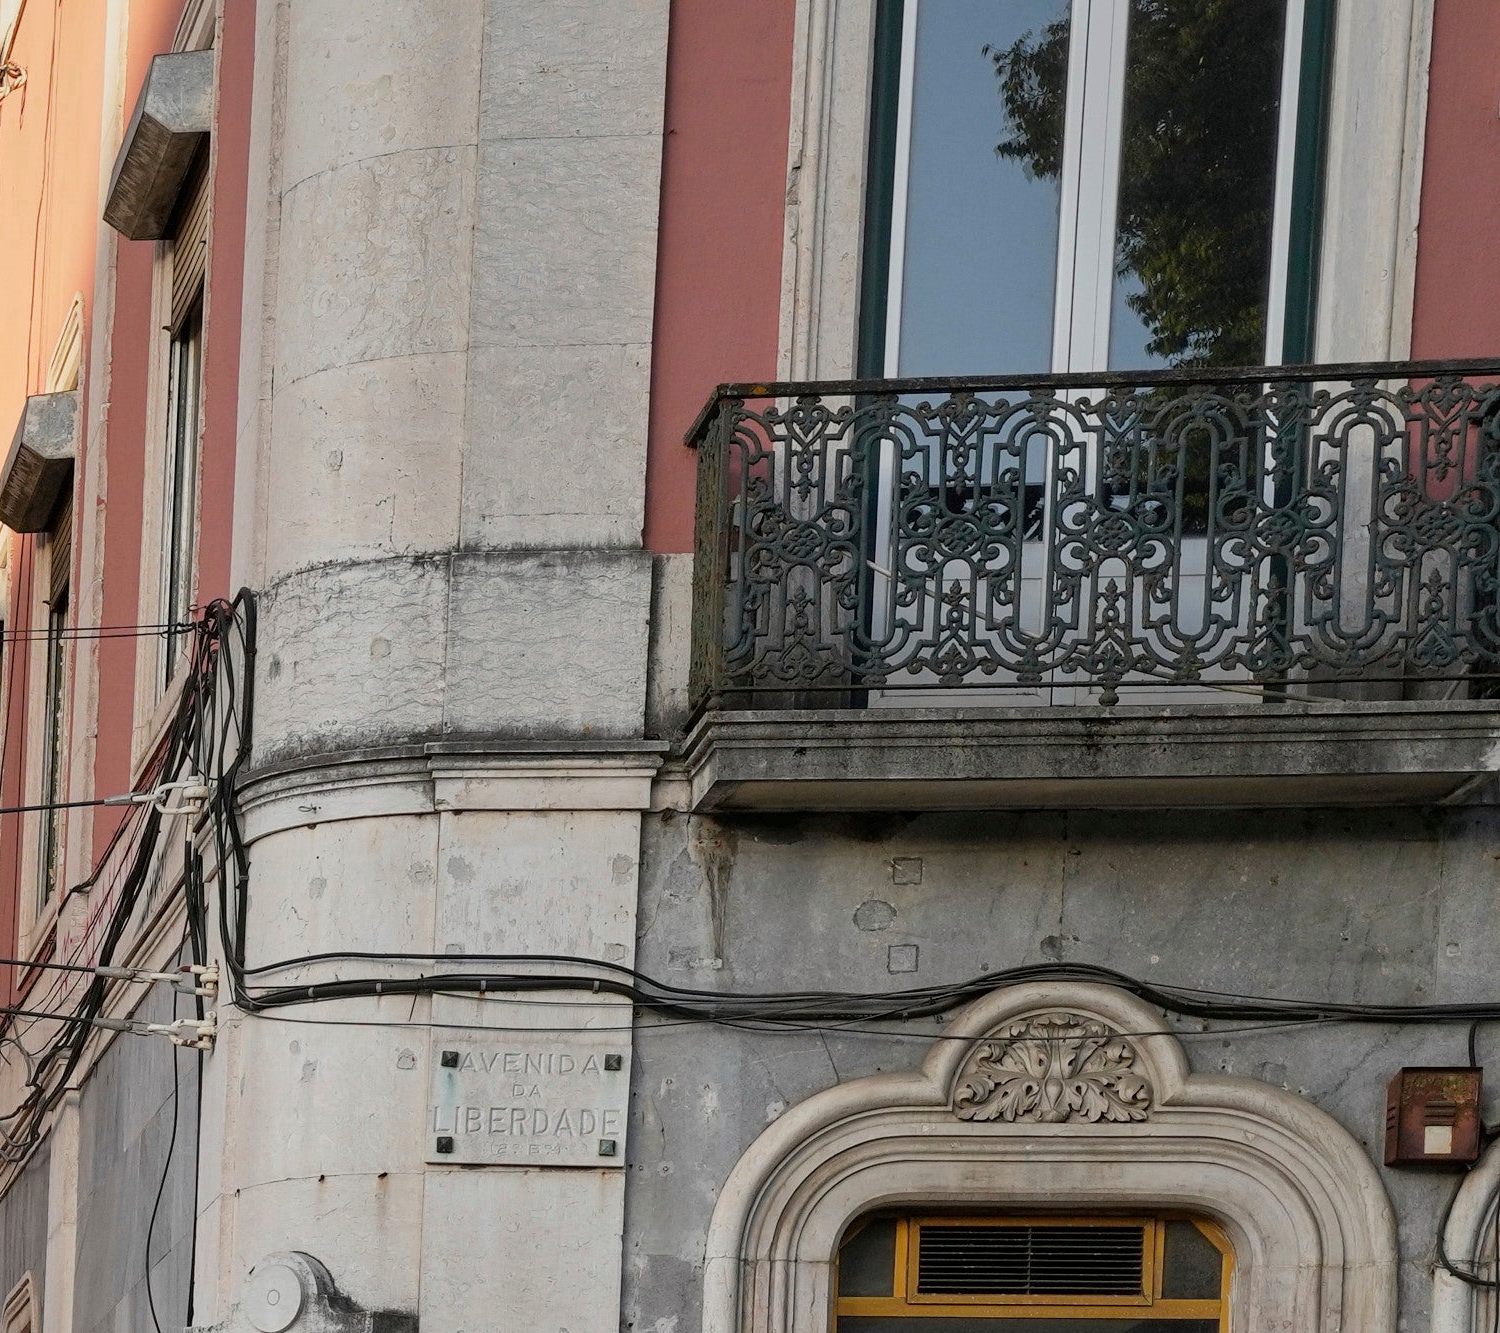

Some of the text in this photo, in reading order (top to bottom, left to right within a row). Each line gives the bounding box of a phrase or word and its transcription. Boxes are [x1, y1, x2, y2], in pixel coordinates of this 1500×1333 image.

[459, 1052, 600, 1075] AVENIDA
[512, 1084, 541, 1098] DA
[433, 1106, 621, 1136] LIBERDADE
